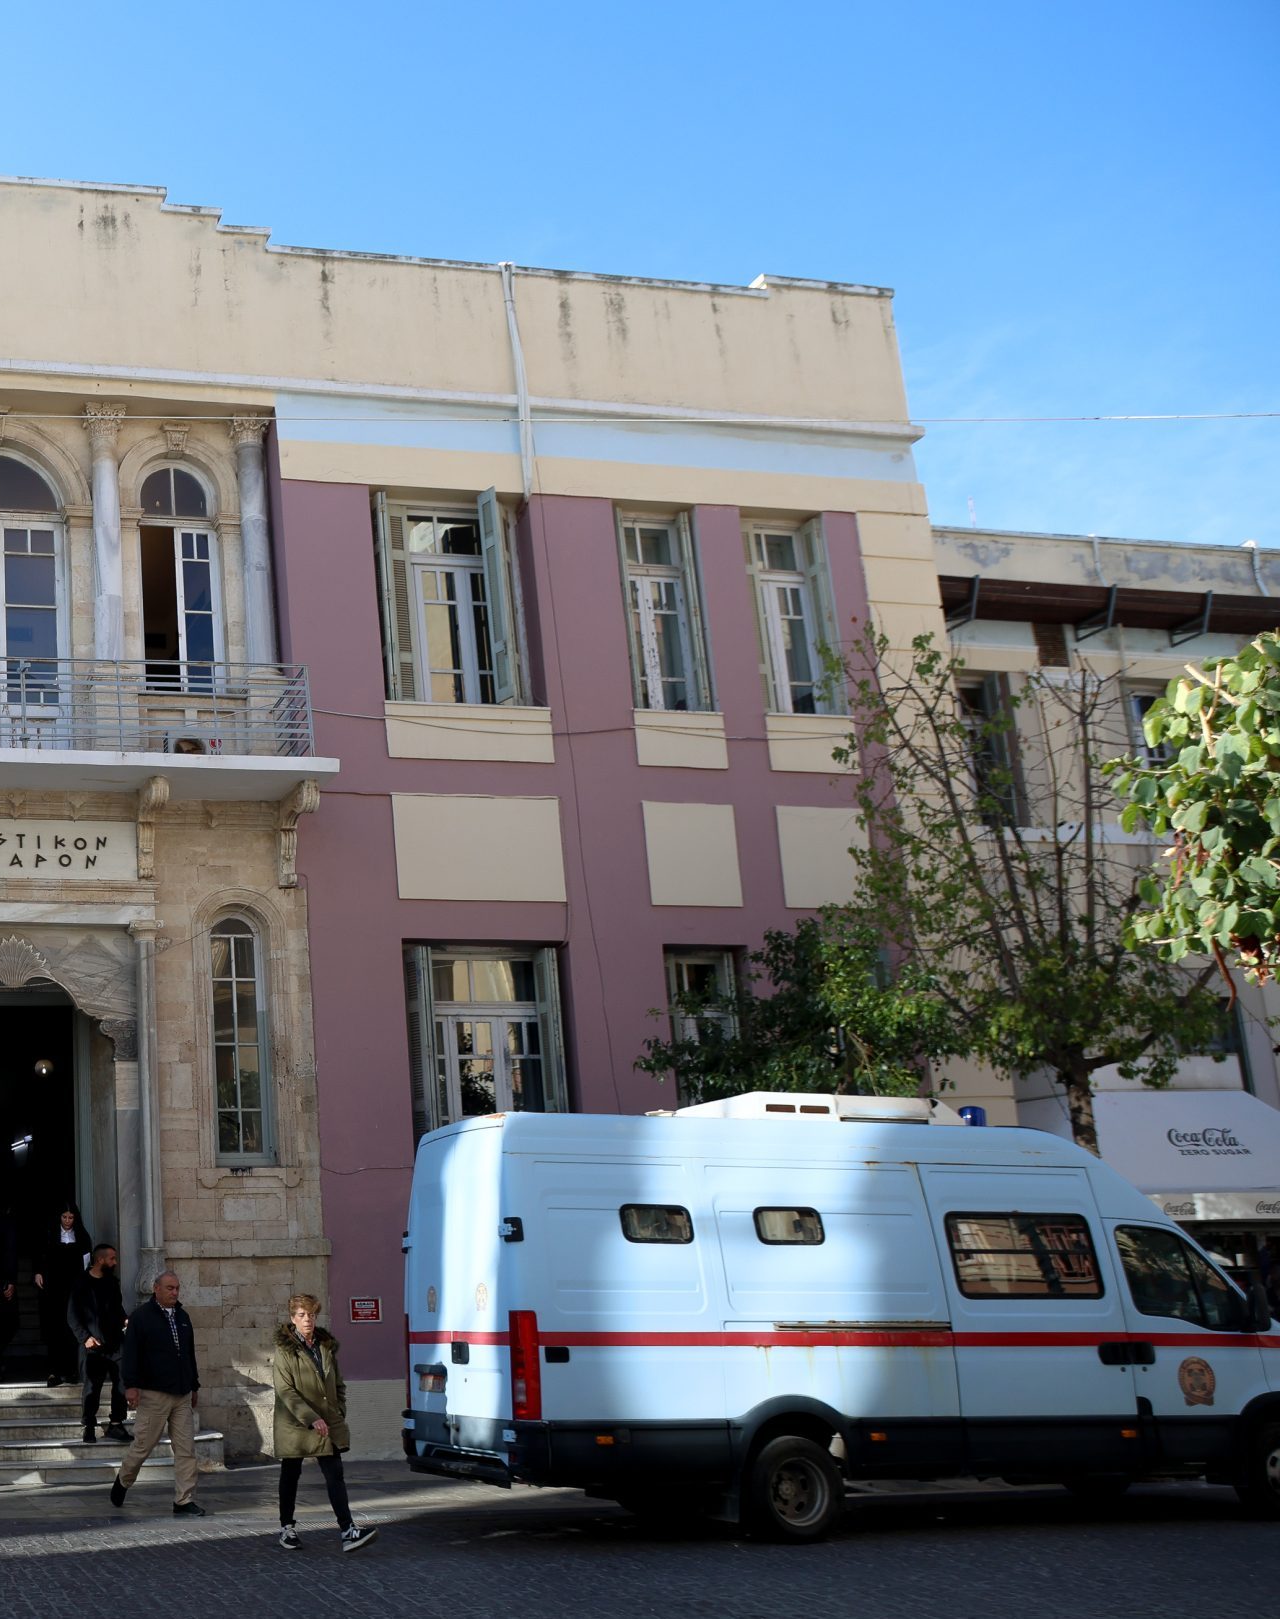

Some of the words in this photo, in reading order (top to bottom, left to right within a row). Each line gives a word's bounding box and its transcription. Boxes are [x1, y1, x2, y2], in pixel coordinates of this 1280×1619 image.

[1178, 1148, 1210, 1156] ZERO
[1211, 1148, 1252, 1156] SUGAR
[352, 1530, 360, 1538] N
